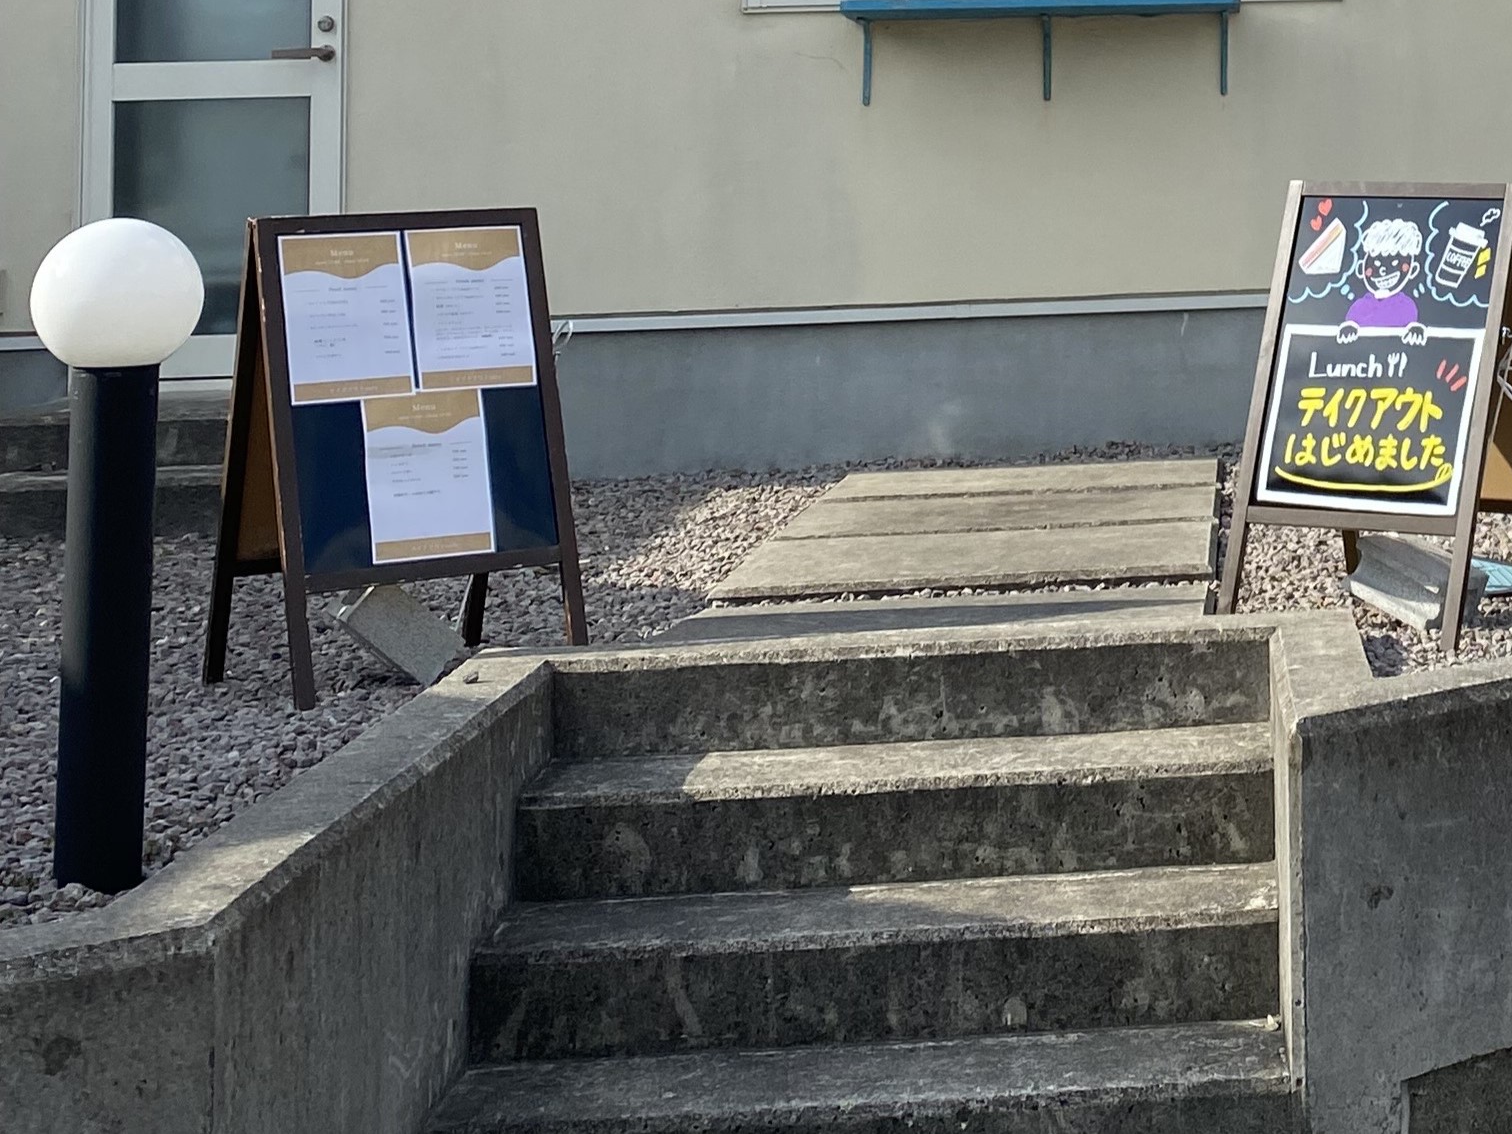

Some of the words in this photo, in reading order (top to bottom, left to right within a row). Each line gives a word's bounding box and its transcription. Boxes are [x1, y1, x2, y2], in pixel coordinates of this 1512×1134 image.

[1308, 351, 1383, 378] Lunch
[1298, 387, 1443, 433] テイクアウト
[1284, 432, 1446, 471] はじめました
